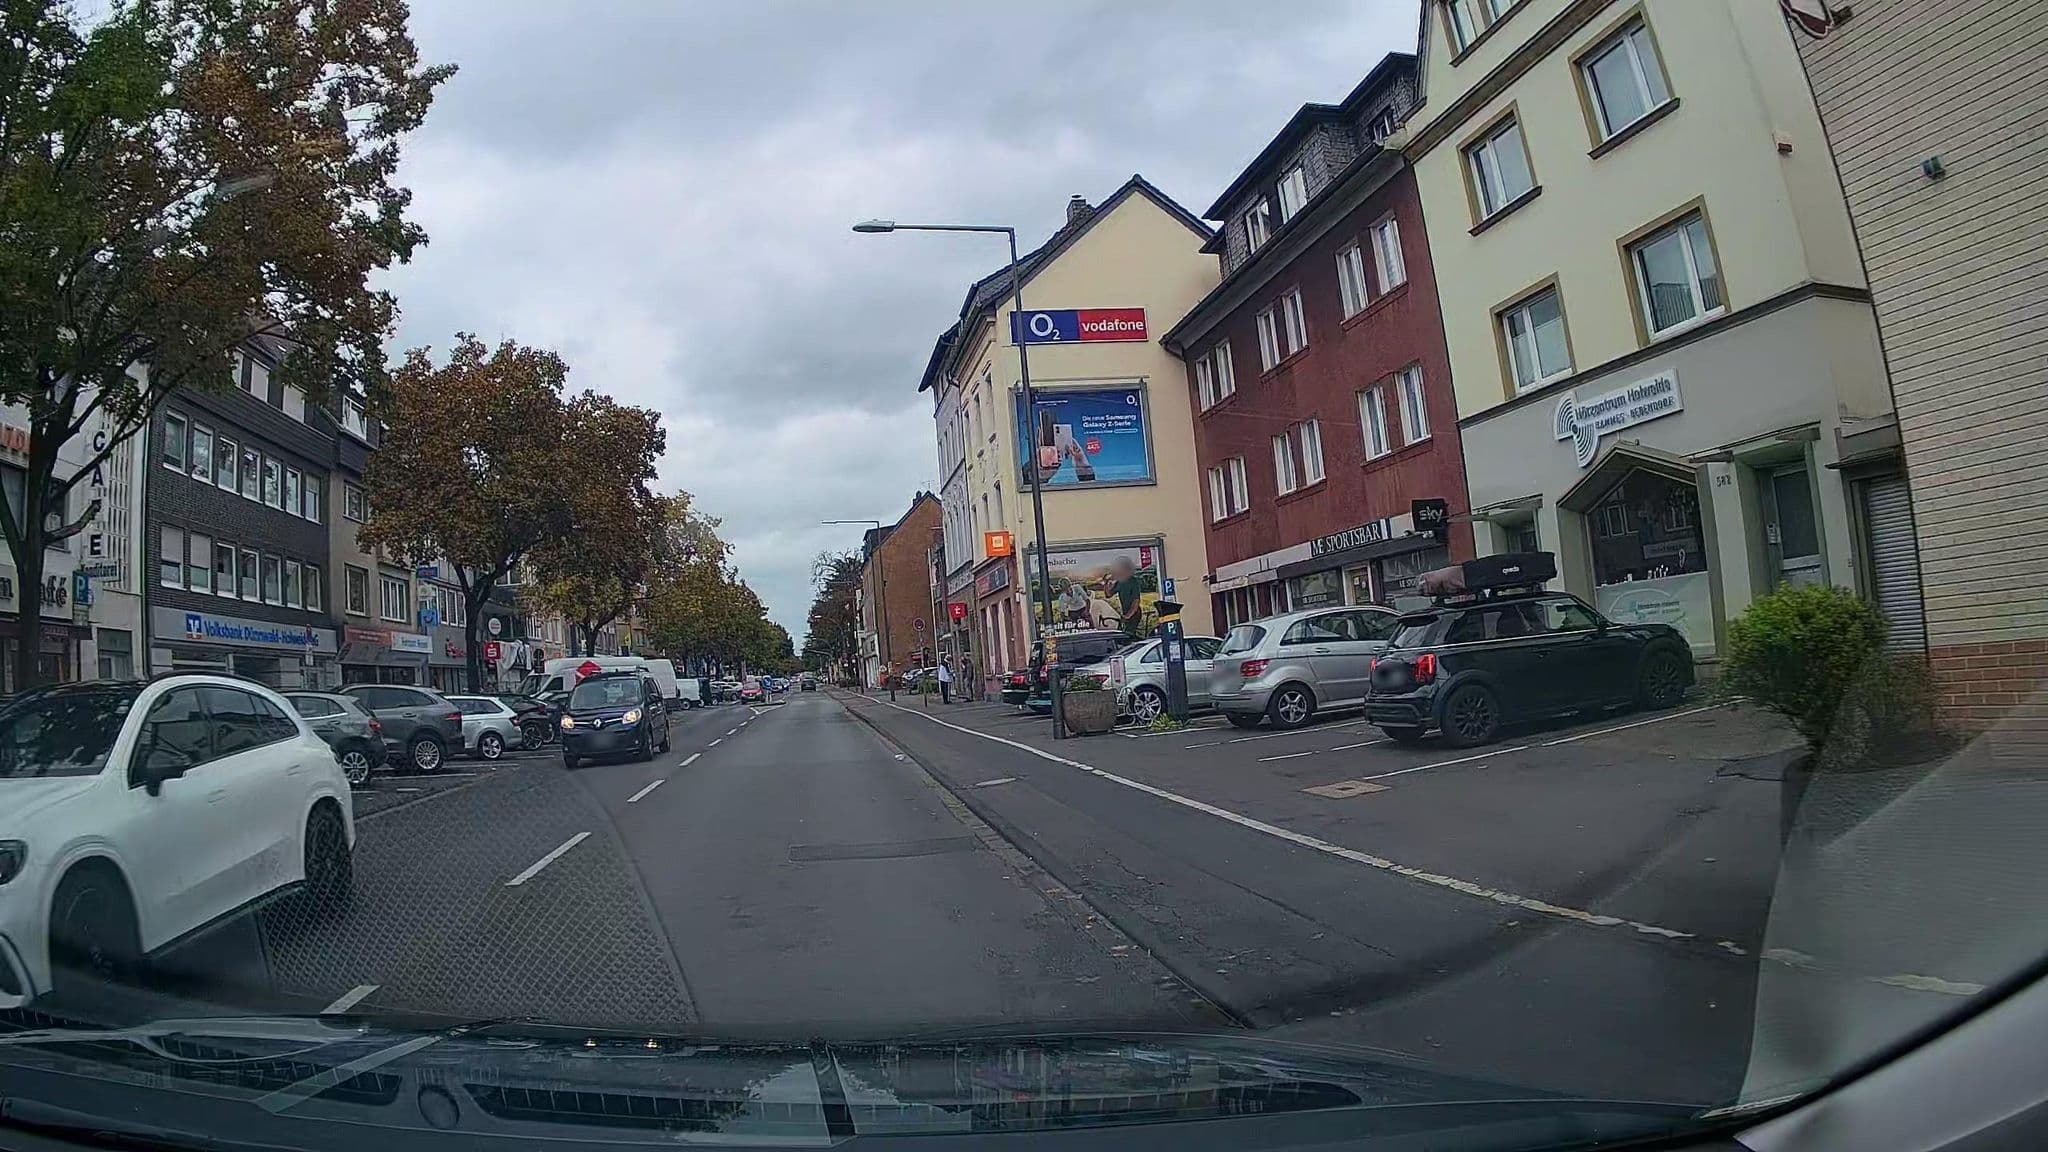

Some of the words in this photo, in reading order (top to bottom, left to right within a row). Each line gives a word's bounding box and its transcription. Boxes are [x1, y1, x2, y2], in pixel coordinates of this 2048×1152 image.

[1081, 319, 1144, 332] vodafone
[1419, 506, 1443, 523] sky
[1326, 523, 1381, 553] SPORTSBAR
[204, 620, 243, 641] Volksbank
